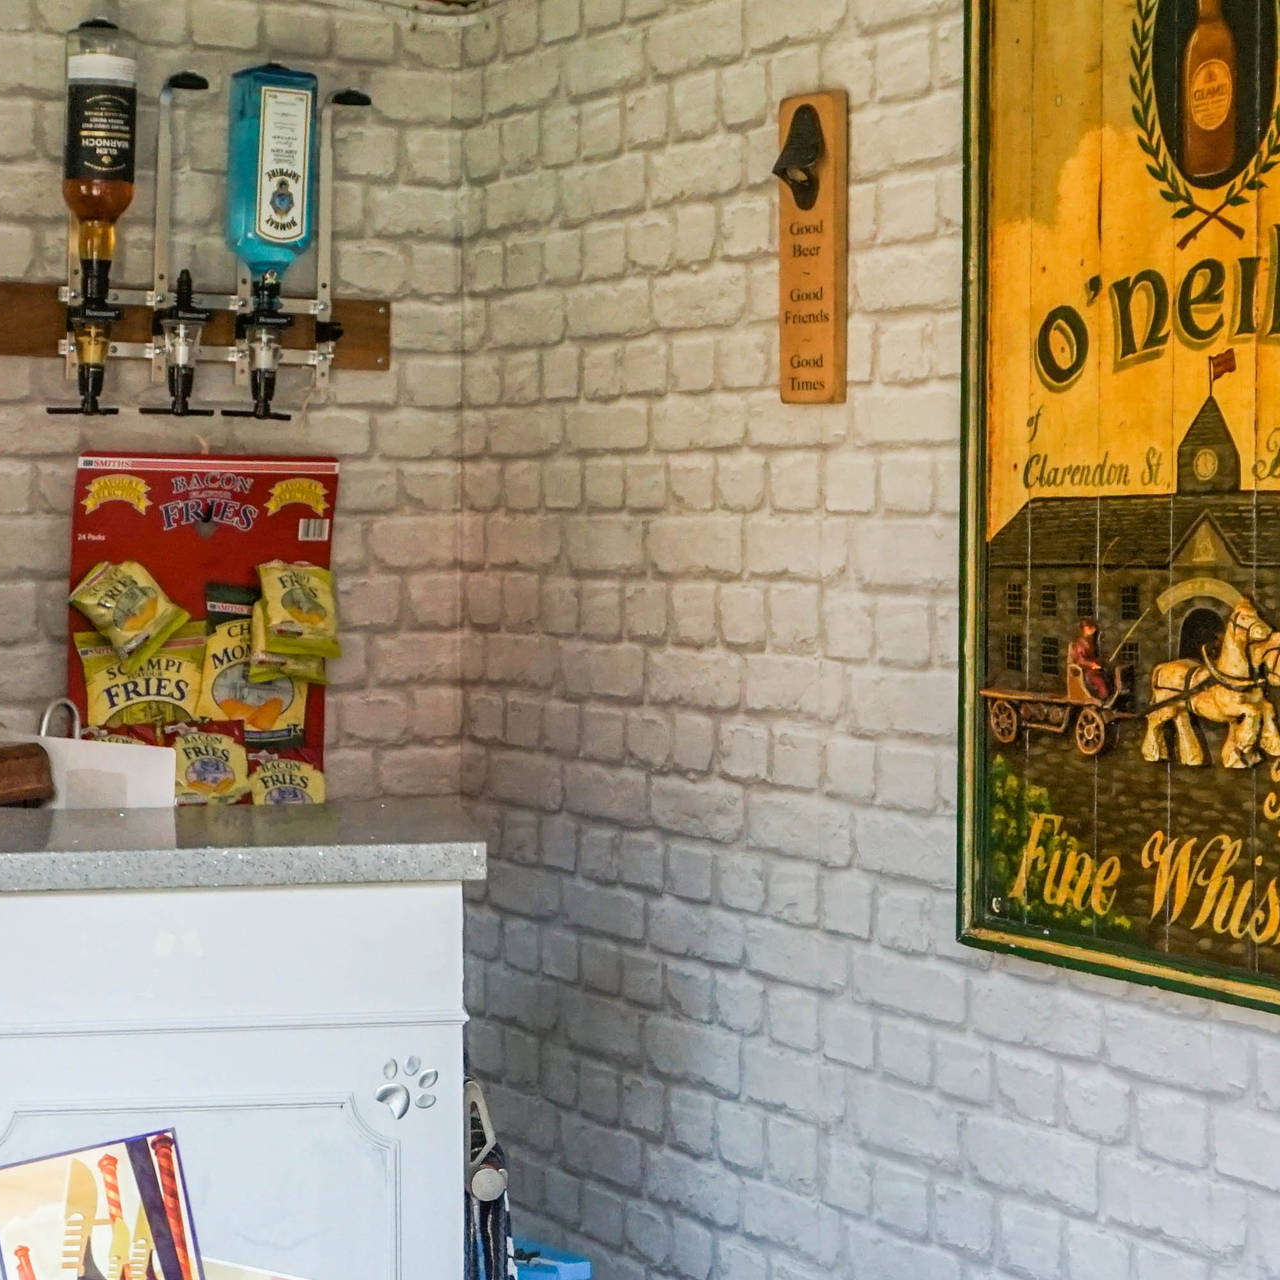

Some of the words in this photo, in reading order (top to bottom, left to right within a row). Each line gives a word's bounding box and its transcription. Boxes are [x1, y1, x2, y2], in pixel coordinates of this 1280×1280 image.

[789, 220, 824, 236] Good
[792, 243, 821, 258] Beer
[789, 287, 824, 303] Good
[784, 310, 830, 326] Friends
[789, 354, 824, 370] Good
[788, 376, 825, 392] Times
[1026, 405, 1043, 443] of
[1023, 450, 1131, 489] Clarendon
[172, 472, 254, 494] BACON
[160, 498, 259, 532] FRIES
[103, 678, 190, 710] FRIES
[182, 746, 231, 763] FRIES
[260, 773, 309, 790] FRIES
[1009, 813, 1122, 916] Fine
